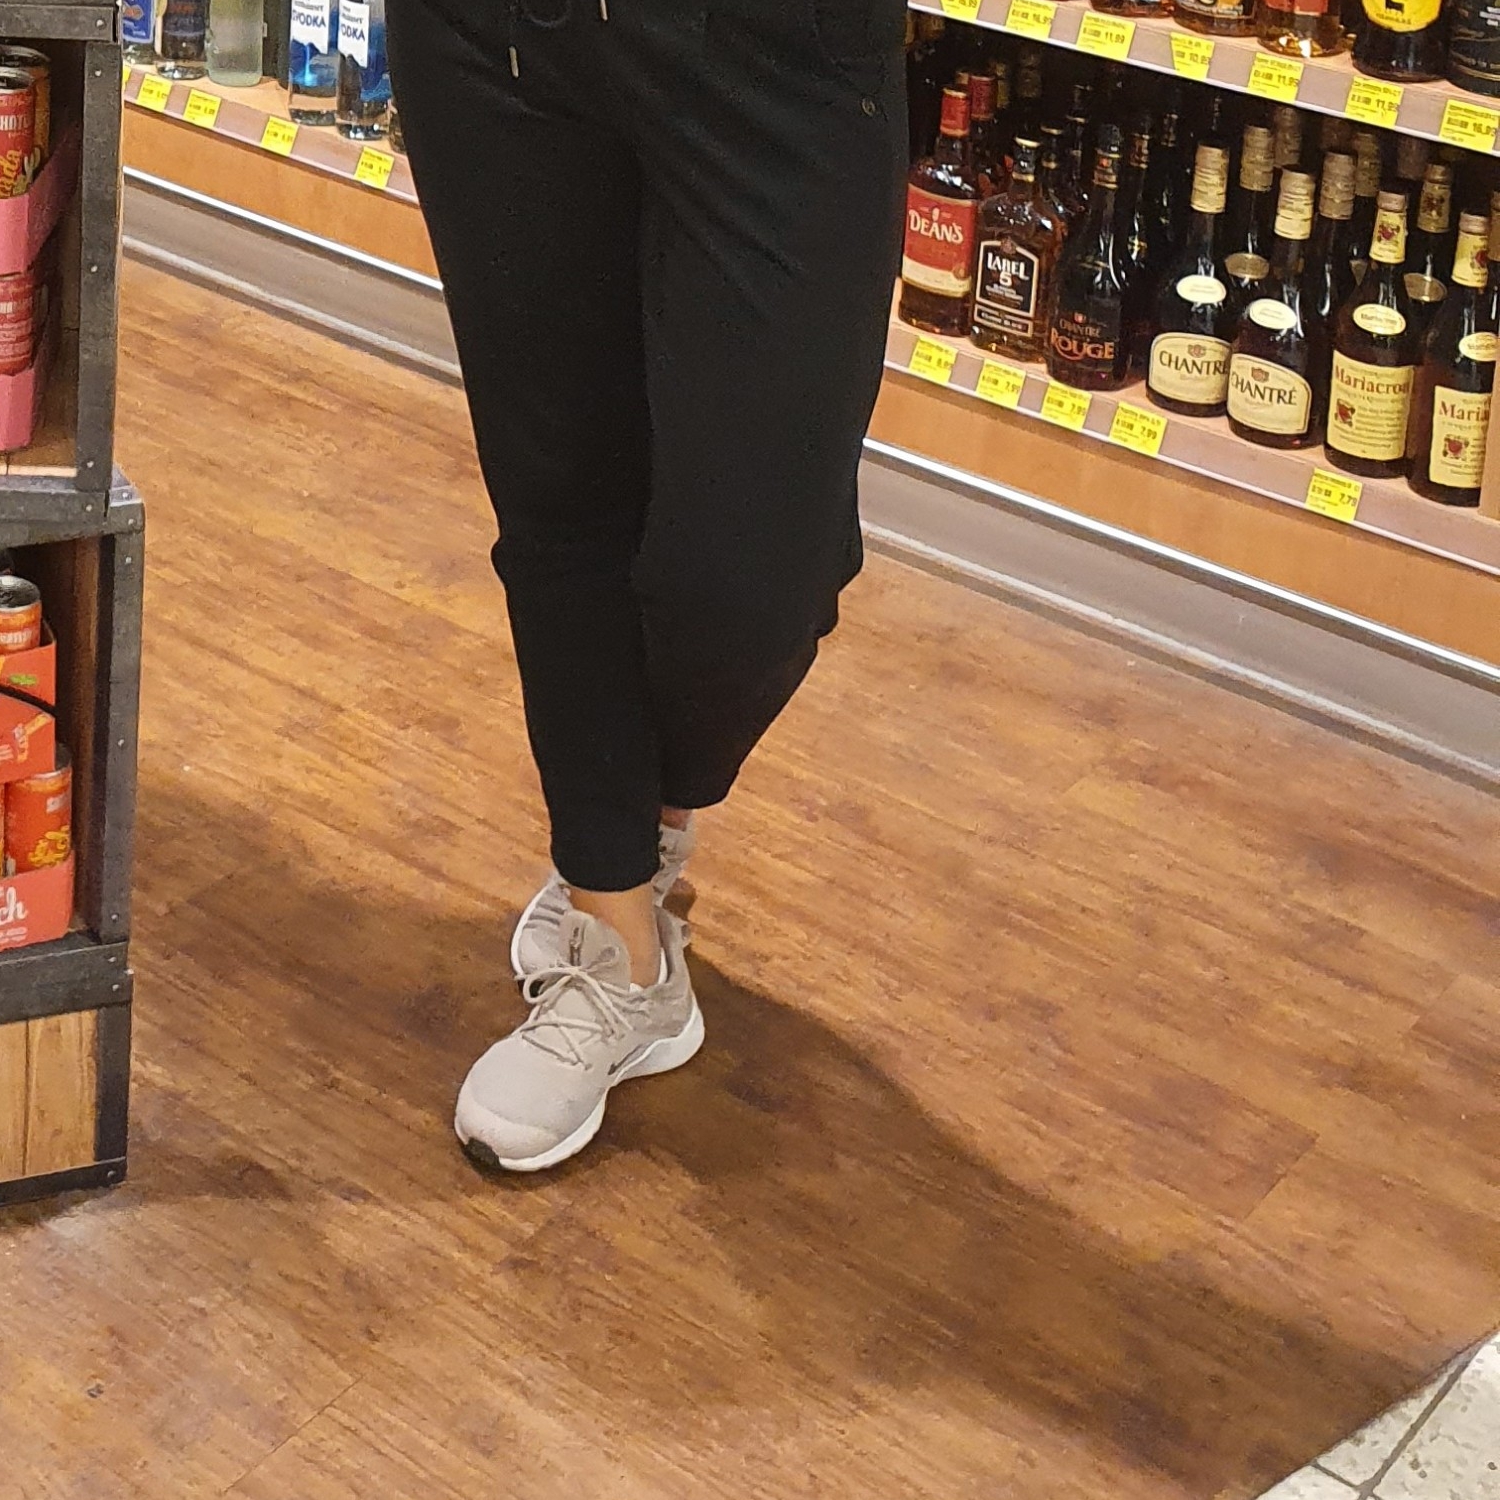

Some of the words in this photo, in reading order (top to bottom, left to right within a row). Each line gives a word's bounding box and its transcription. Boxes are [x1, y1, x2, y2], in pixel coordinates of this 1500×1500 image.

[908, 210, 964, 245] DEAN'S
[986, 252, 1030, 281] LABEL
[999, 270, 1014, 287] 5
[1050, 327, 1115, 361] ROUGE
